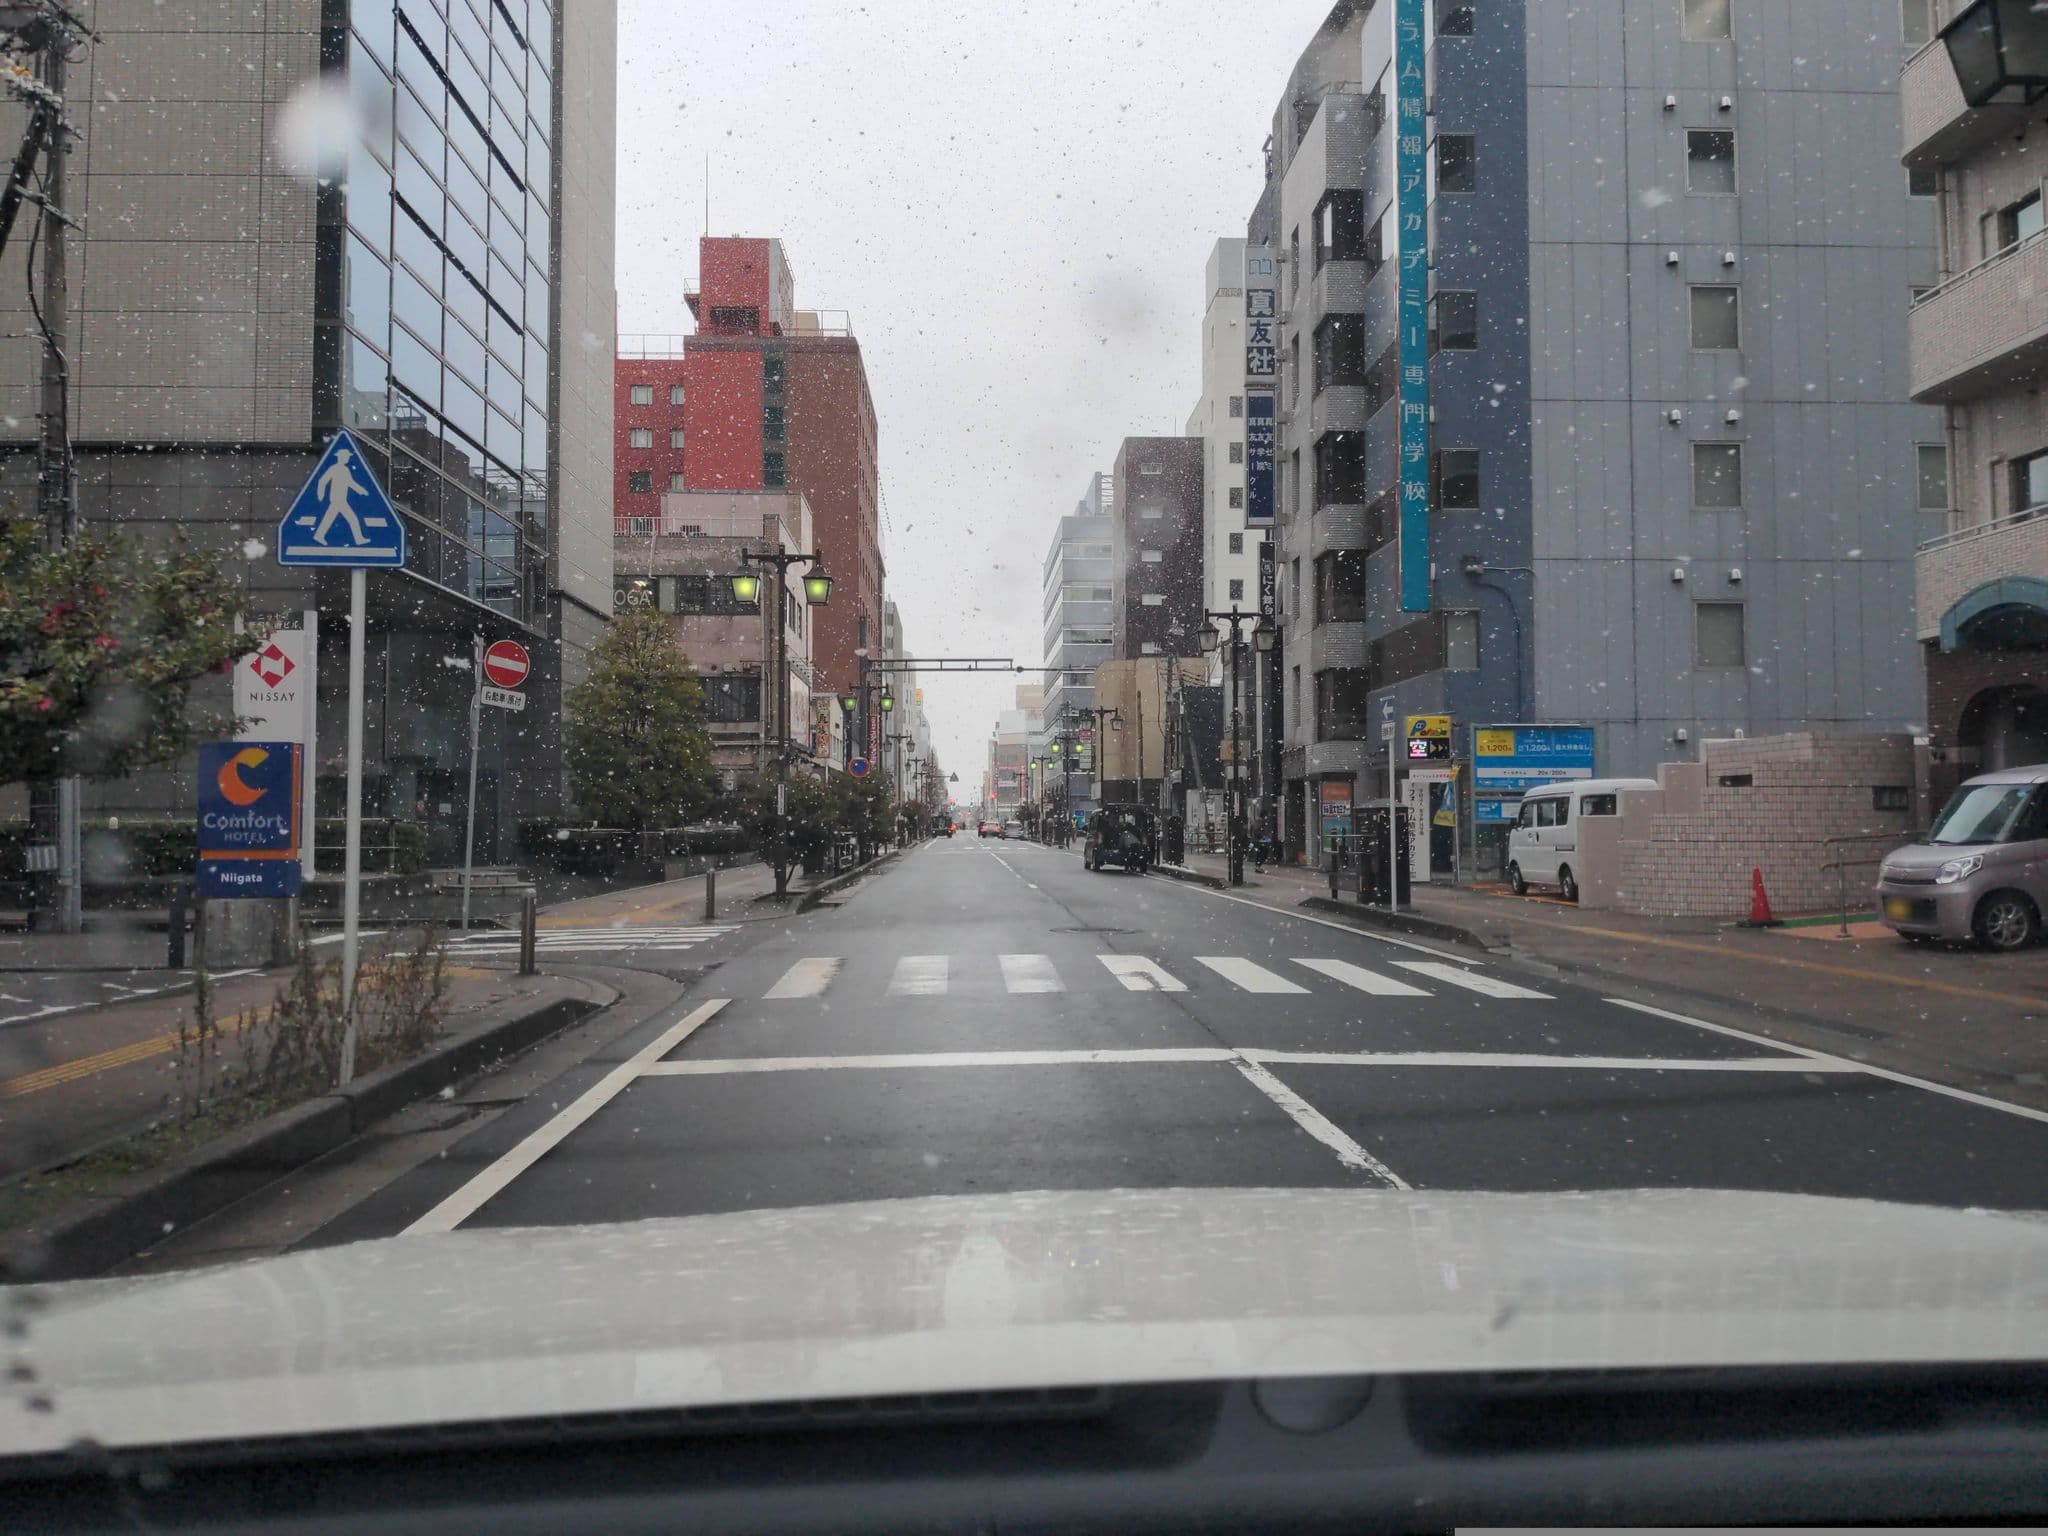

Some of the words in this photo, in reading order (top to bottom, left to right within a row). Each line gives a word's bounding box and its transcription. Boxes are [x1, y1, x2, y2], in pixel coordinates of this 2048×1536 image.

[1402, 0, 1425, 500] ラム情報アカデミー専門学校
[1248, 289, 1274, 375] 真友社
[250, 692, 295, 701] NISSAY
[203, 810, 283, 830] Comfort
[224, 832, 266, 841] HOTEL
[220, 872, 263, 885] Niigata
